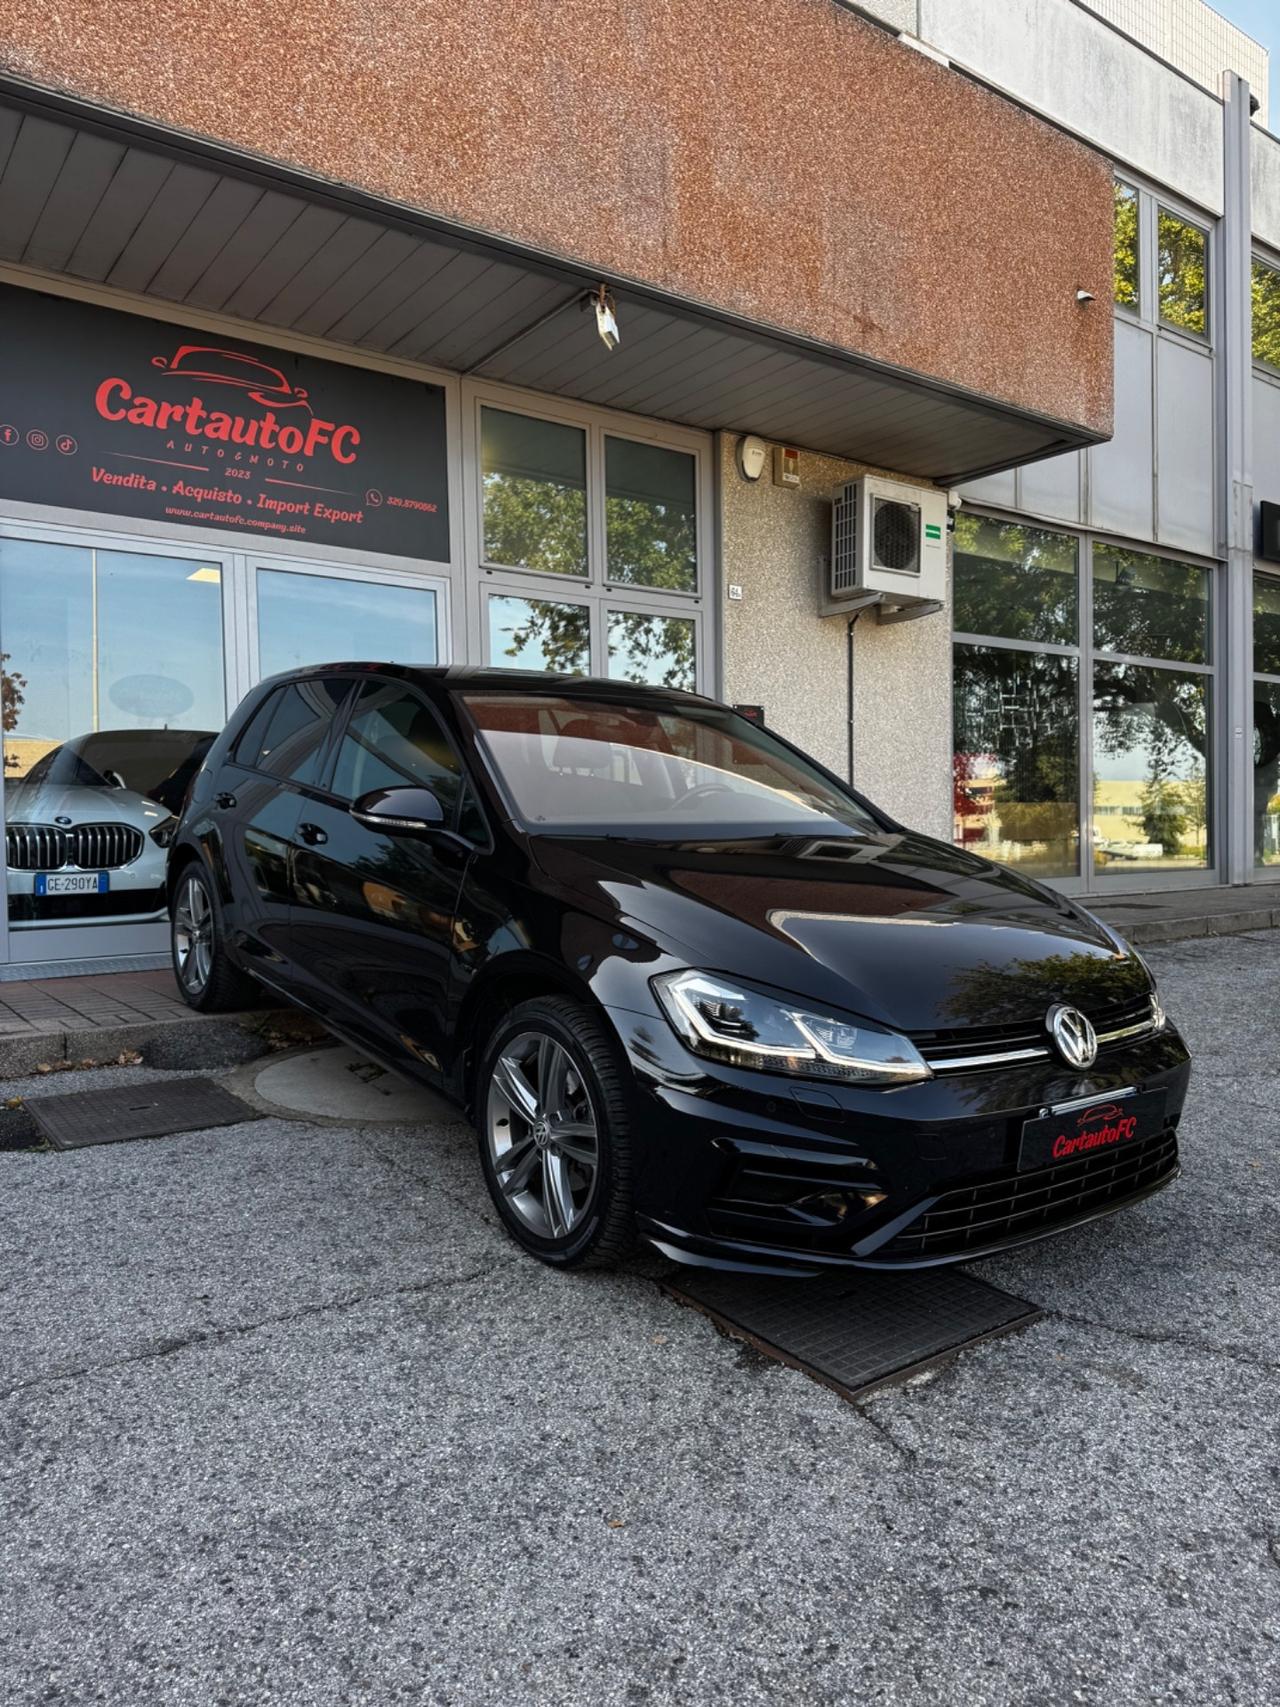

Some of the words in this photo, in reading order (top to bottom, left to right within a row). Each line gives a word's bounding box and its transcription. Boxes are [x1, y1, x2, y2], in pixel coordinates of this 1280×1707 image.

[95, 377, 361, 464] CartautoFC
[224, 467, 252, 480] 2023
[91, 467, 157, 491] Vendita
[172, 480, 242, 503] Acquisto
[257, 493, 310, 515] Import
[313, 499, 364, 524] Export
[165, 506, 307, 534] www.cartautofc.company.site
[1052, 1116, 1137, 1158] CartautoFC
